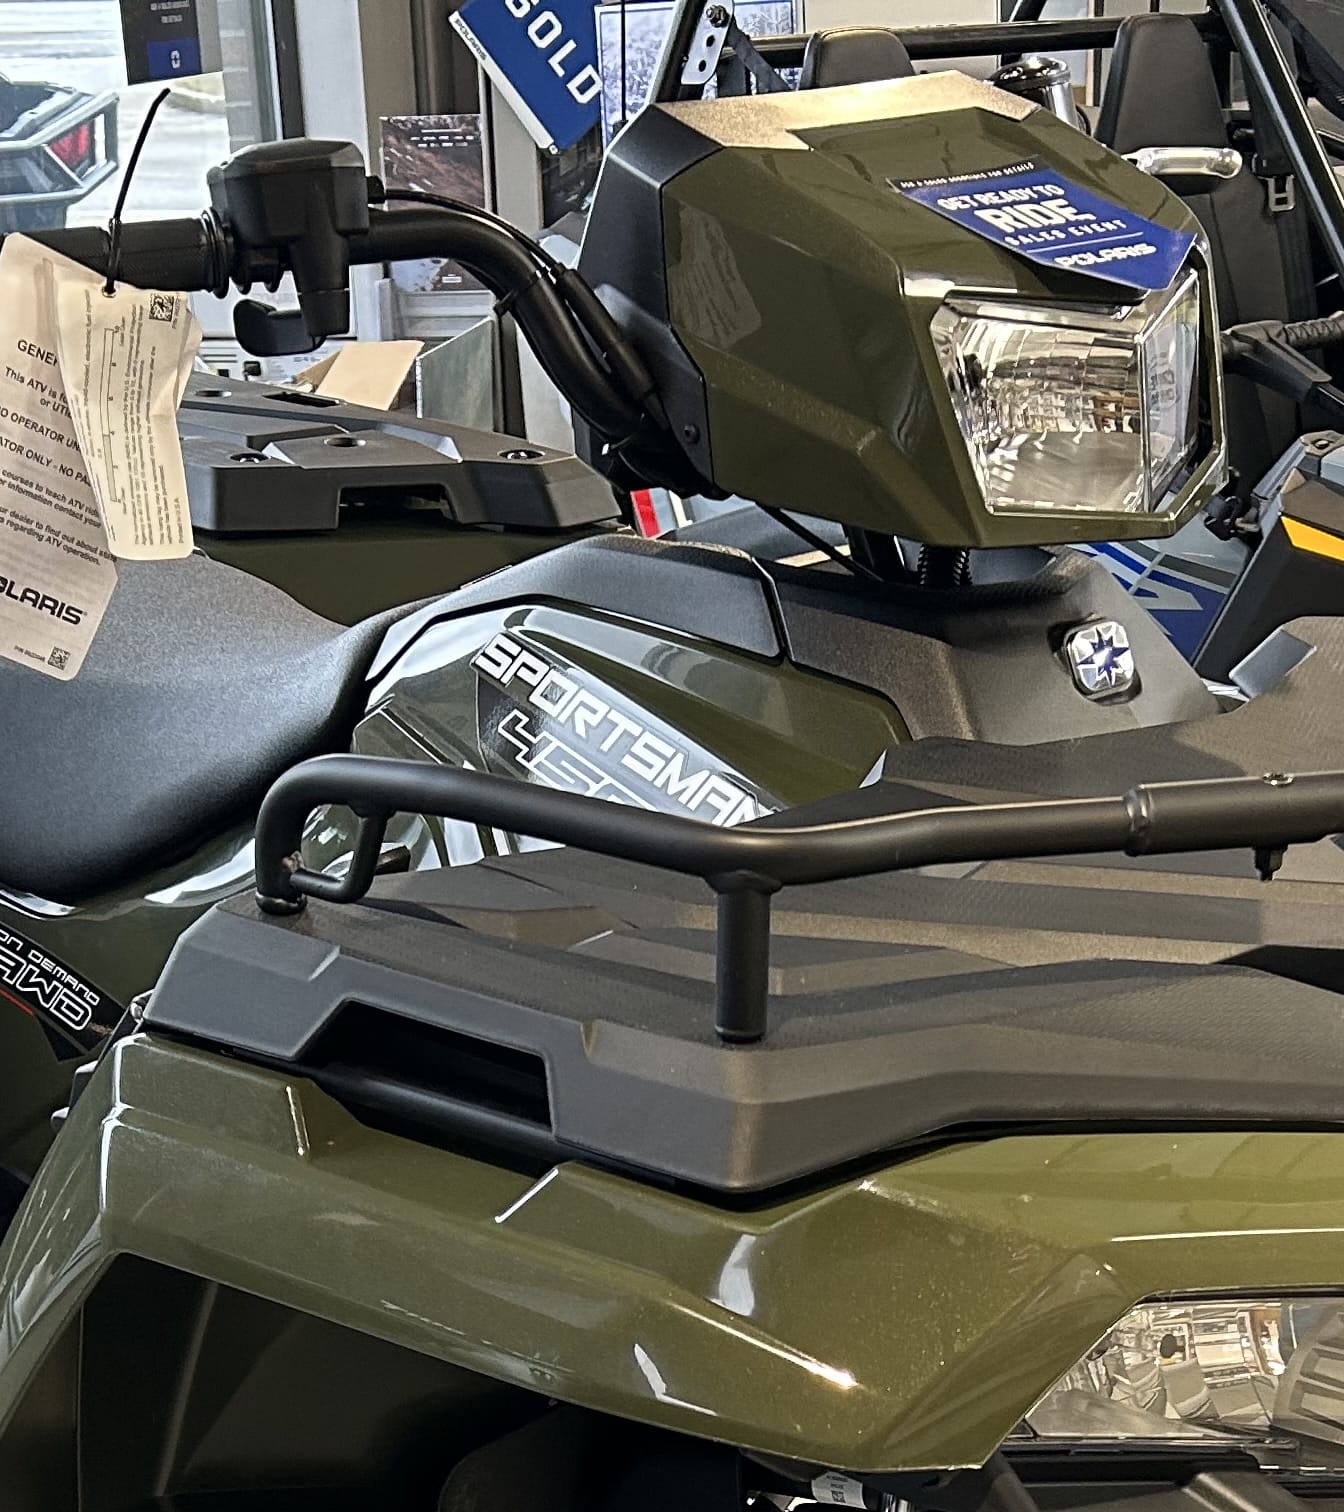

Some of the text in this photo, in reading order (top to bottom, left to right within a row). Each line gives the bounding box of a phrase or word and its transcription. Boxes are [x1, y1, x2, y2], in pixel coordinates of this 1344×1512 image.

[936, 184, 1066, 211] GET READY TO
[1005, 218, 1128, 247] SALES EVENT
[1053, 243, 1158, 267] POLARIS
[5, 366, 25, 384] This
[27, 377, 48, 395] ATV
[48, 387, 58, 399] is
[39, 397, 51, 408] or
[10, 411, 65, 444] OPERATOR
[26, 448, 52, 468] ONLY
[58, 463, 74, 478] NO
[2, 468, 33, 488] courses
[67, 497, 84, 511] ATV
[7, 480, 52, 507] information
[53, 501, 84, 521] contact
[9, 508, 35, 526] dealer
[6, 516, 45, 542] regarding
[45, 534, 62, 549] ATV
